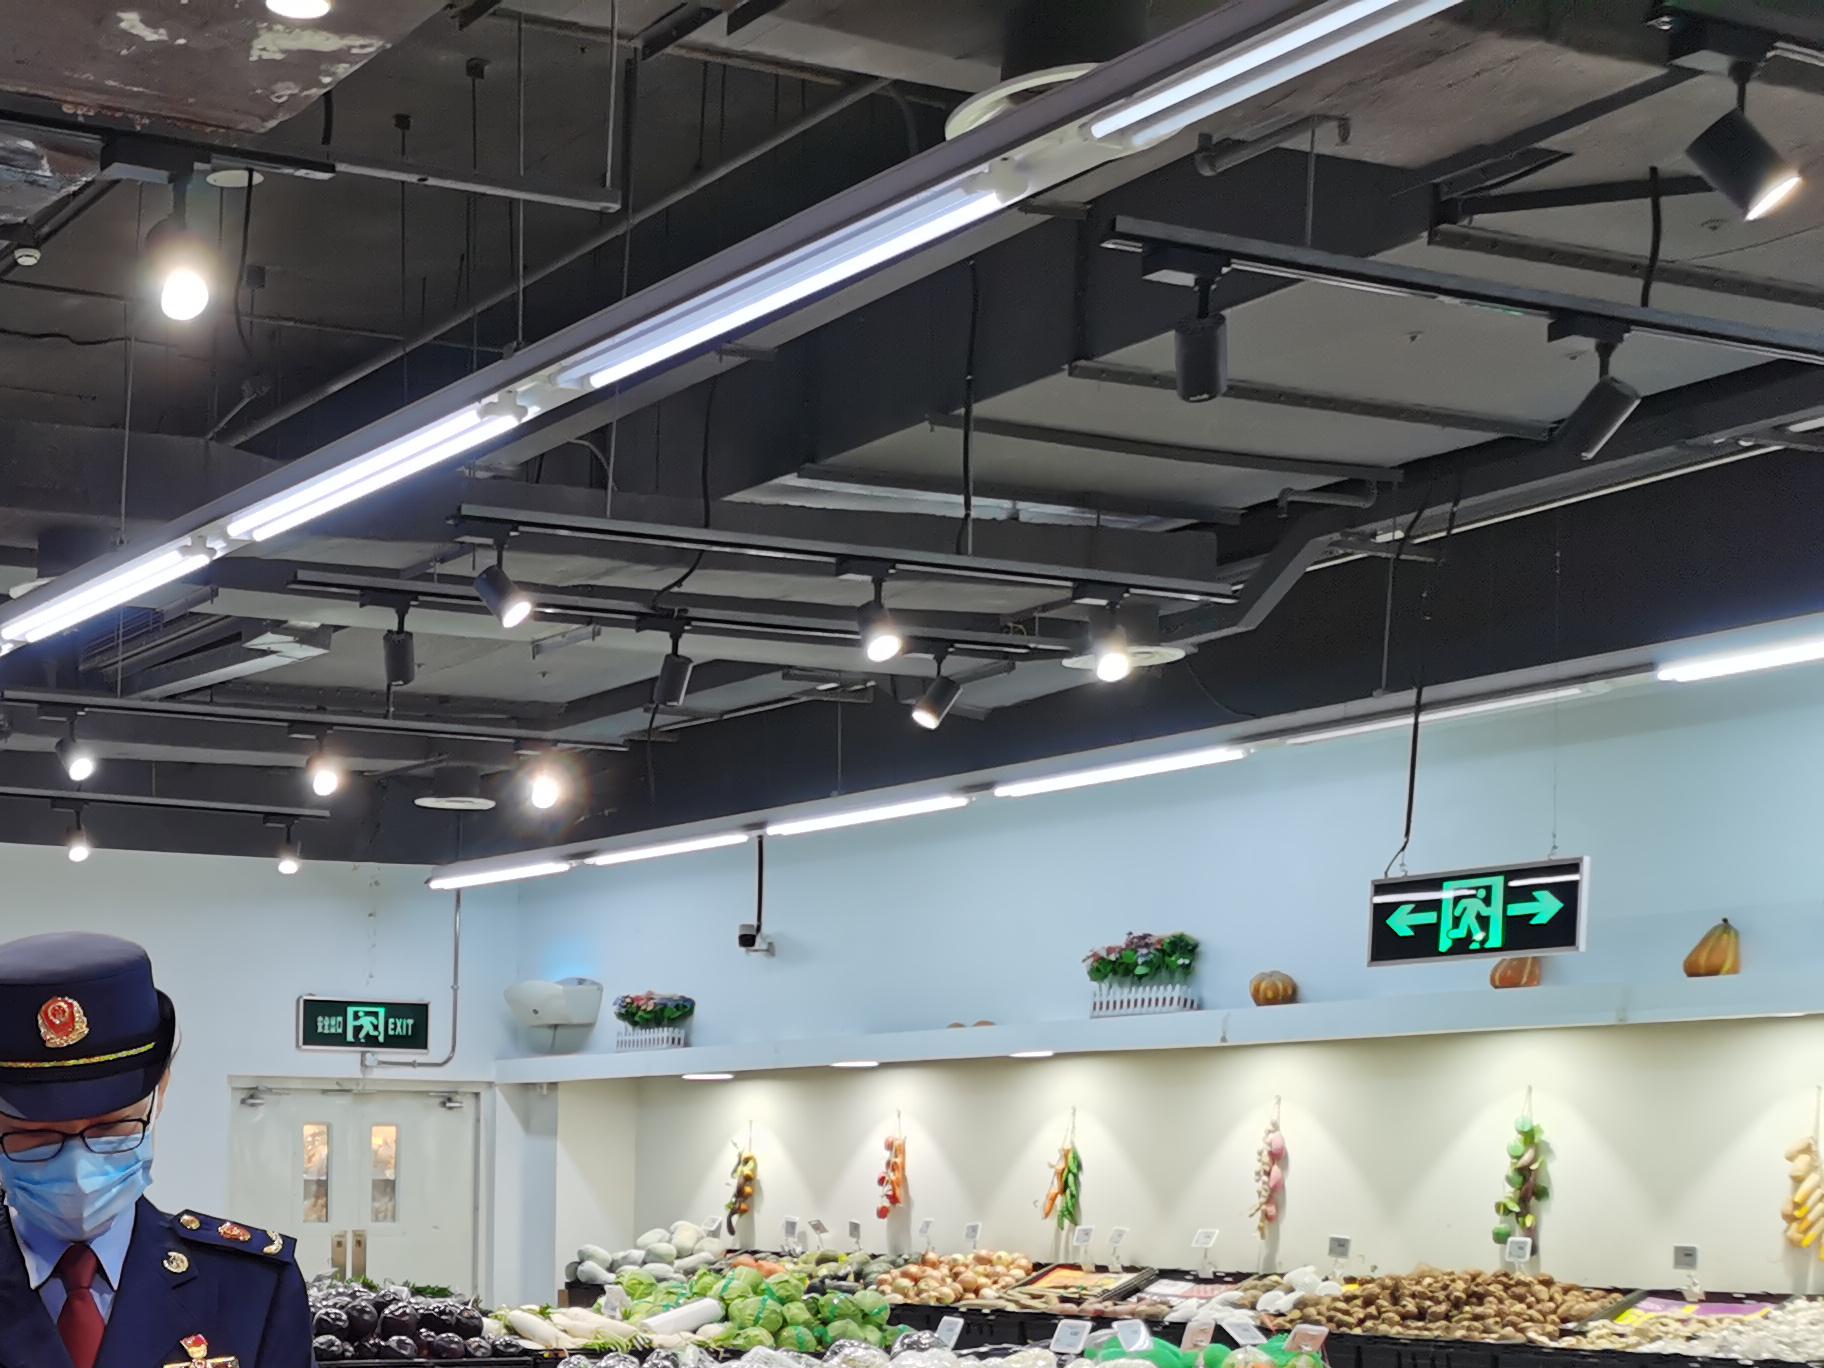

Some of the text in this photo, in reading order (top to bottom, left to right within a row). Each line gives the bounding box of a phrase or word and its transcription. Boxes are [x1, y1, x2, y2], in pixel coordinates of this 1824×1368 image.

[317, 1016, 343, 1034] 安全出口
[388, 1018, 414, 1036] EXIT
